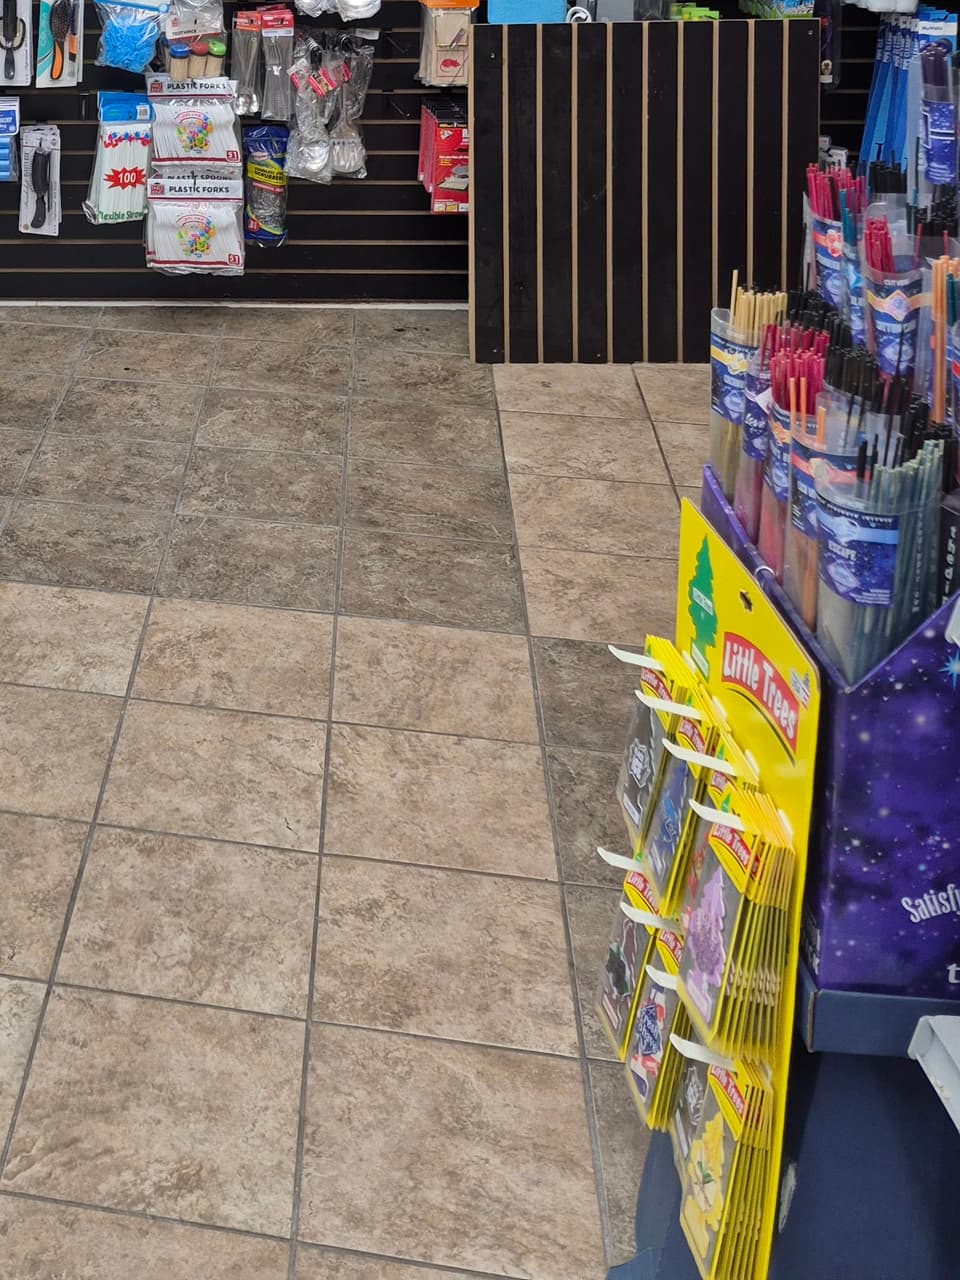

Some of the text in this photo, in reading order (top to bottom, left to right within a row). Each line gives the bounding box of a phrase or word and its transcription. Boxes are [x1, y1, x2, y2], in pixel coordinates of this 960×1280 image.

[167, 82, 226, 90] PLASTIC FORKS
[118, 172, 137, 183] 100
[168, 185, 230, 194] PLASTIC FORKS
[827, 539, 857, 562] ESCAPE
[723, 640, 797, 740] Little Trees
[713, 824, 750, 868] Little Trees
[626, 870, 645, 893] Little
[711, 1063, 746, 1115] Little Trees
